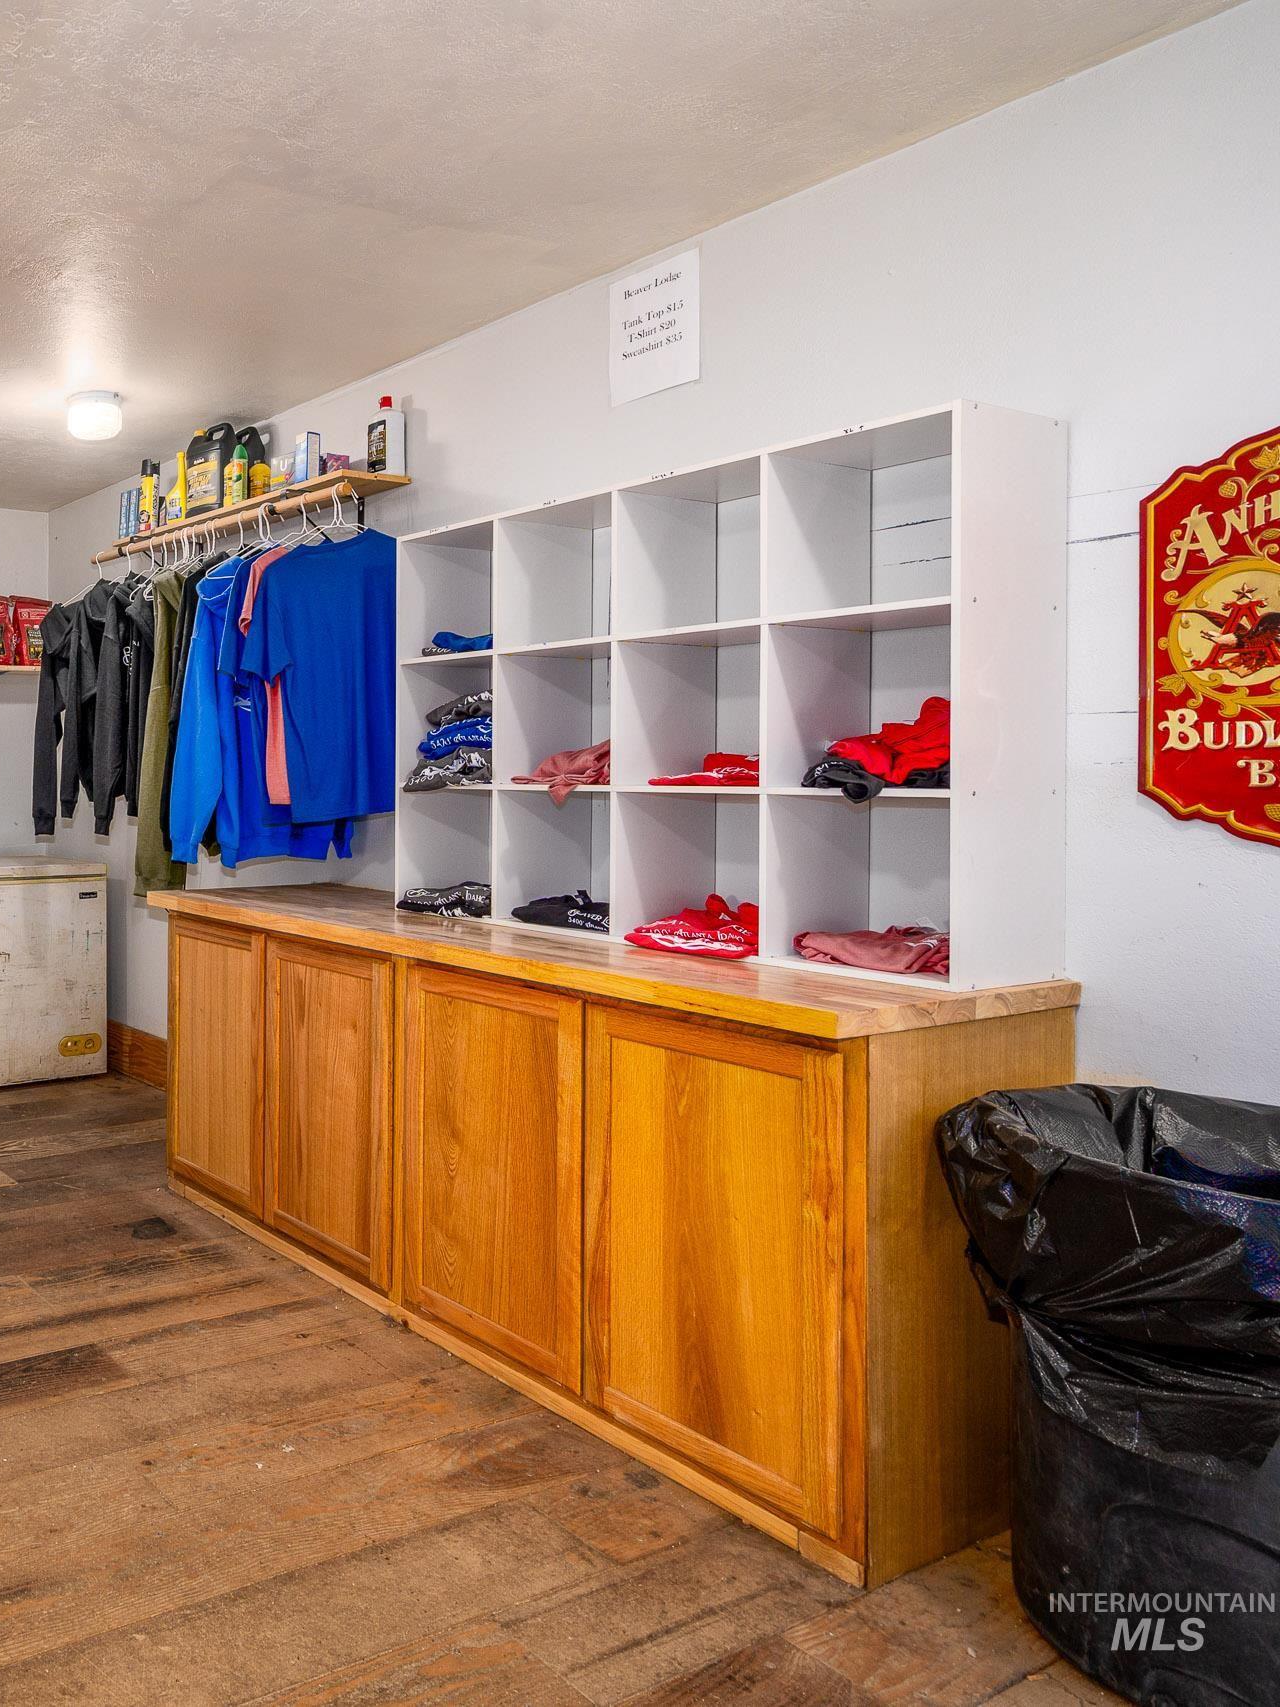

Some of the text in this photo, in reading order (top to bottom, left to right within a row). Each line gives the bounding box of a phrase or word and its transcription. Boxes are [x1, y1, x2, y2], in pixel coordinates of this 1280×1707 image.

[624, 272, 682, 300] Beaver Lodge
[622, 299, 684, 330] Tank Top $15
[628, 319, 676, 343] T-Shirt $20
[622, 331, 683, 360] Sweatshirt $35
